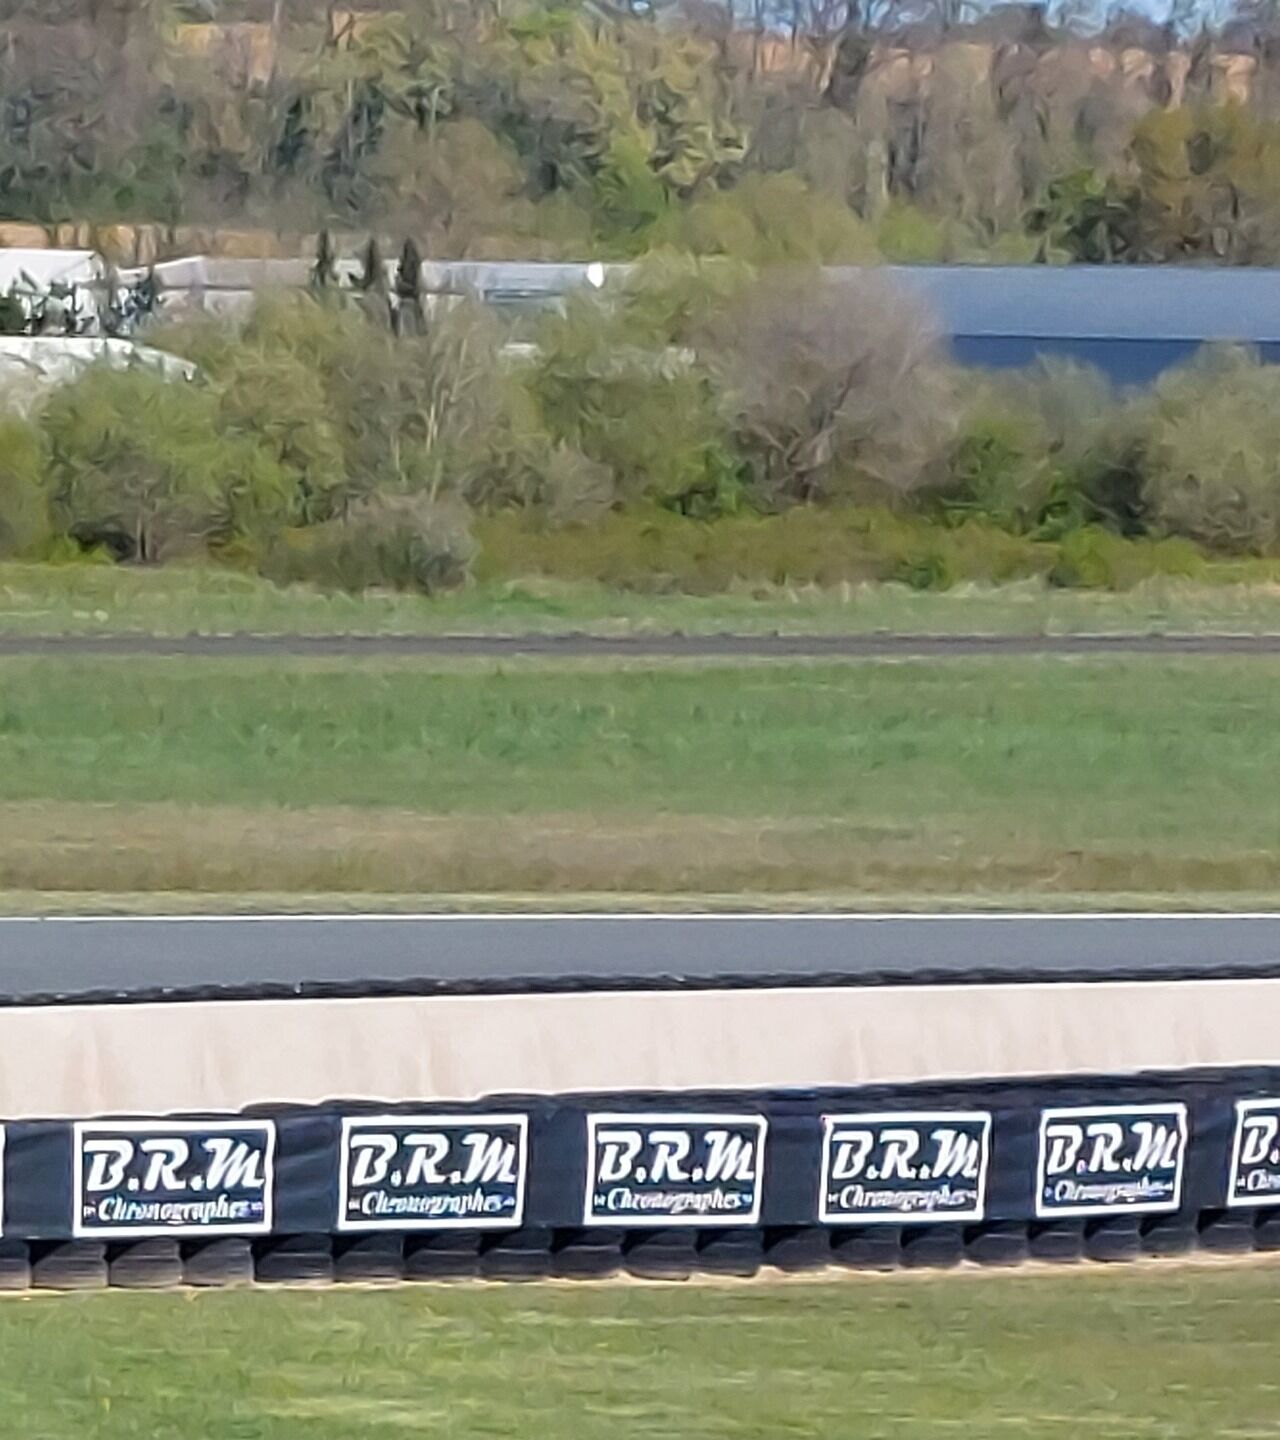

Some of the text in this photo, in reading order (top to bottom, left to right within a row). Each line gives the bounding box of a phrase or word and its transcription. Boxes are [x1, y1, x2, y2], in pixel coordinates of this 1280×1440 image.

[83, 1138, 265, 1192] B.R.M
[350, 1132, 517, 1186] B.R.M
[597, 1130, 755, 1183] B.R.M
[831, 1129, 978, 1180] B.R.M
[1046, 1121, 1178, 1175] B.R.M
